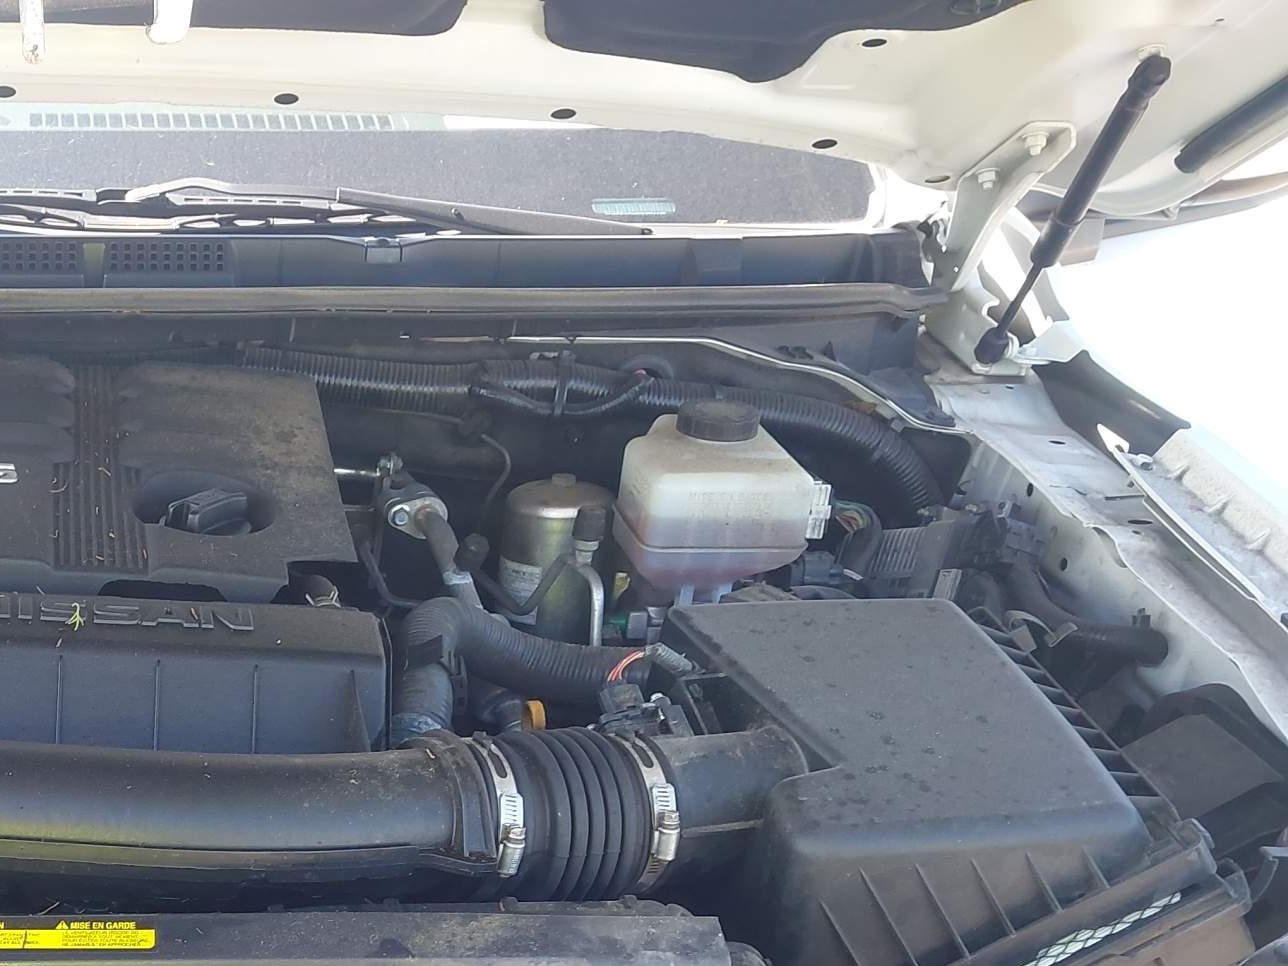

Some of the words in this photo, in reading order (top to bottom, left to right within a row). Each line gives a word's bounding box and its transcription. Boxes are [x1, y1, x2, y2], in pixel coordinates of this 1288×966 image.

[70, 921, 91, 930] MISE
[92, 921, 104, 930] EN
[105, 921, 137, 930] GARDE
